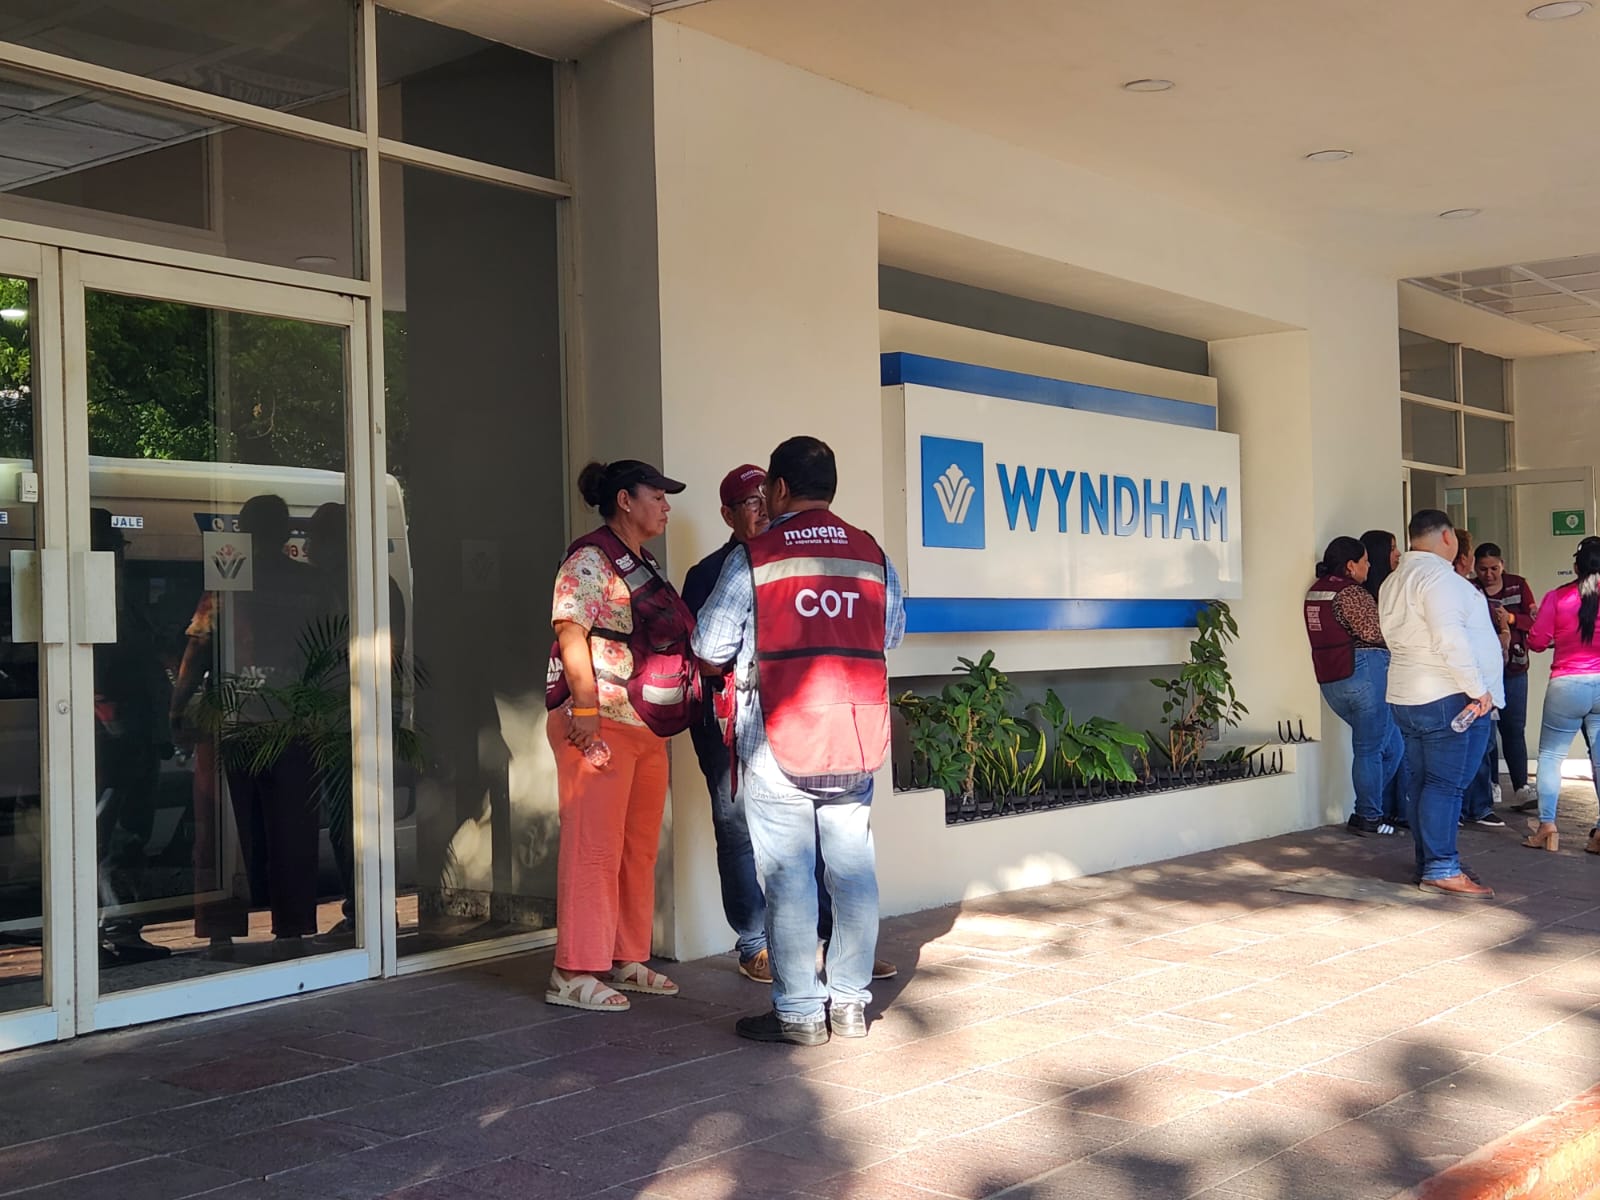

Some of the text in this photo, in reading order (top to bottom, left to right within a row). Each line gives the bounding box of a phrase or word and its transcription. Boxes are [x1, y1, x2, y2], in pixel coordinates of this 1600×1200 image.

[996, 463, 1229, 542] WYNDHAM
[113, 517, 143, 527] JALE
[784, 526, 848, 540] morena
[795, 588, 860, 619] COT
